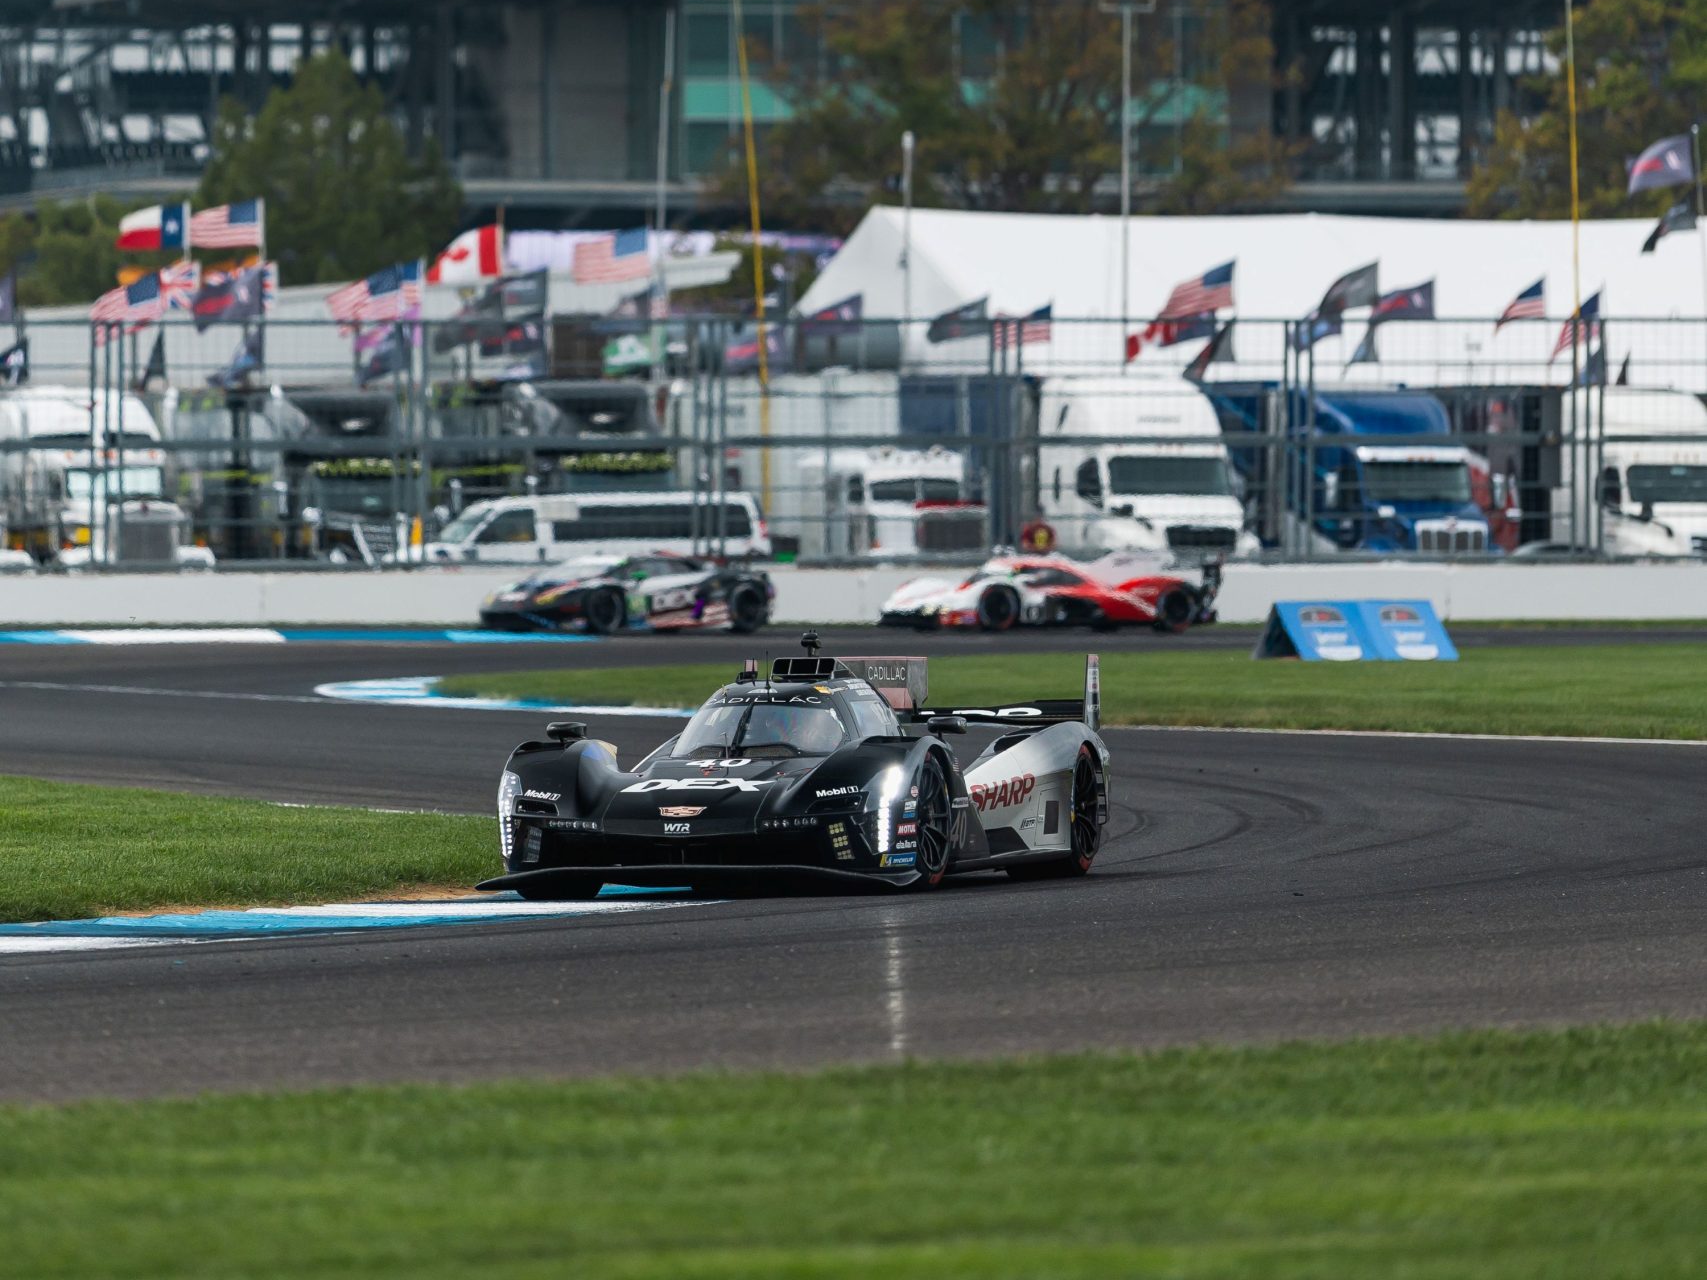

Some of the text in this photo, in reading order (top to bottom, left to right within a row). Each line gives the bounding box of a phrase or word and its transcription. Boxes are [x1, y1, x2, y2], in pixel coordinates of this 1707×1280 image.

[868, 666, 906, 681] CADILLAC
[706, 696, 822, 706] CADILLAC
[685, 758, 752, 768] 40
[620, 778, 777, 792] DEX
[524, 789, 551, 800] Mobil
[816, 787, 847, 798] Mobil
[970, 773, 1036, 812] SHARP
[664, 823, 690, 832] WTR
[898, 823, 916, 834] MOTUL
[950, 809, 967, 849] 40
